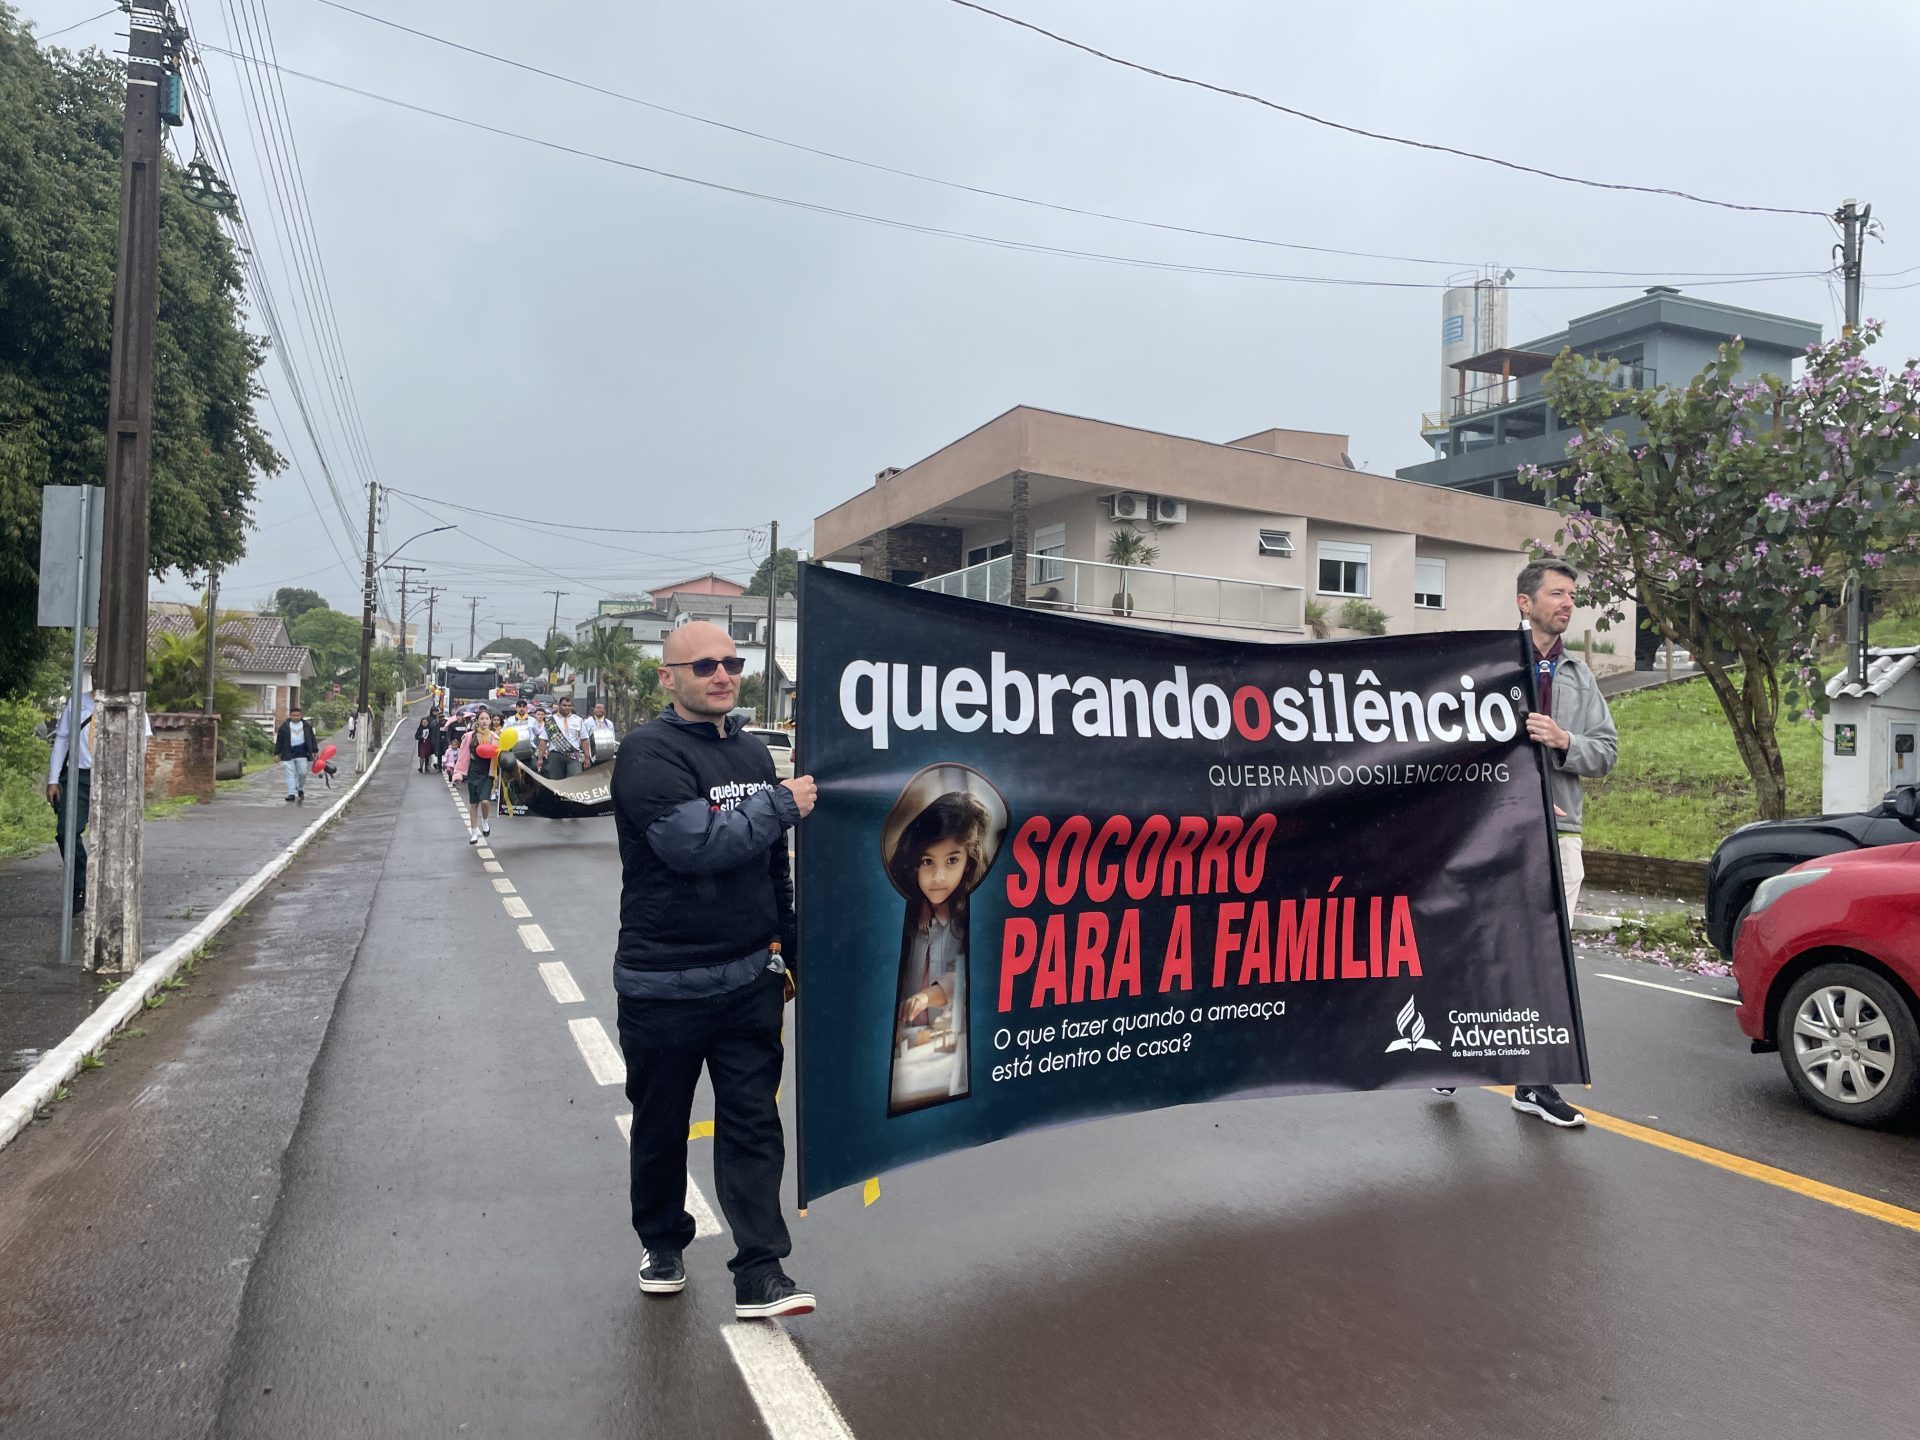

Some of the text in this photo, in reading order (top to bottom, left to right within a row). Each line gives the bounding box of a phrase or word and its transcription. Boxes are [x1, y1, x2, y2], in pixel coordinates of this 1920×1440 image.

[1208, 763, 1510, 787] QUEBRANDOOSILENCIO.ORG
[1006, 812, 1277, 908] SOCORRO
[998, 875, 1423, 1013] PARA A FAMÍLIA
[994, 1000, 1286, 1050] O que fazer quando a ameaça
[1448, 1008, 1540, 1024] Comunidade
[1450, 1023, 1570, 1047] Adventista
[1452, 1047, 1530, 1058] do Bairro São Cristóvão
[991, 1032, 1192, 1082] está dentro de casa?
